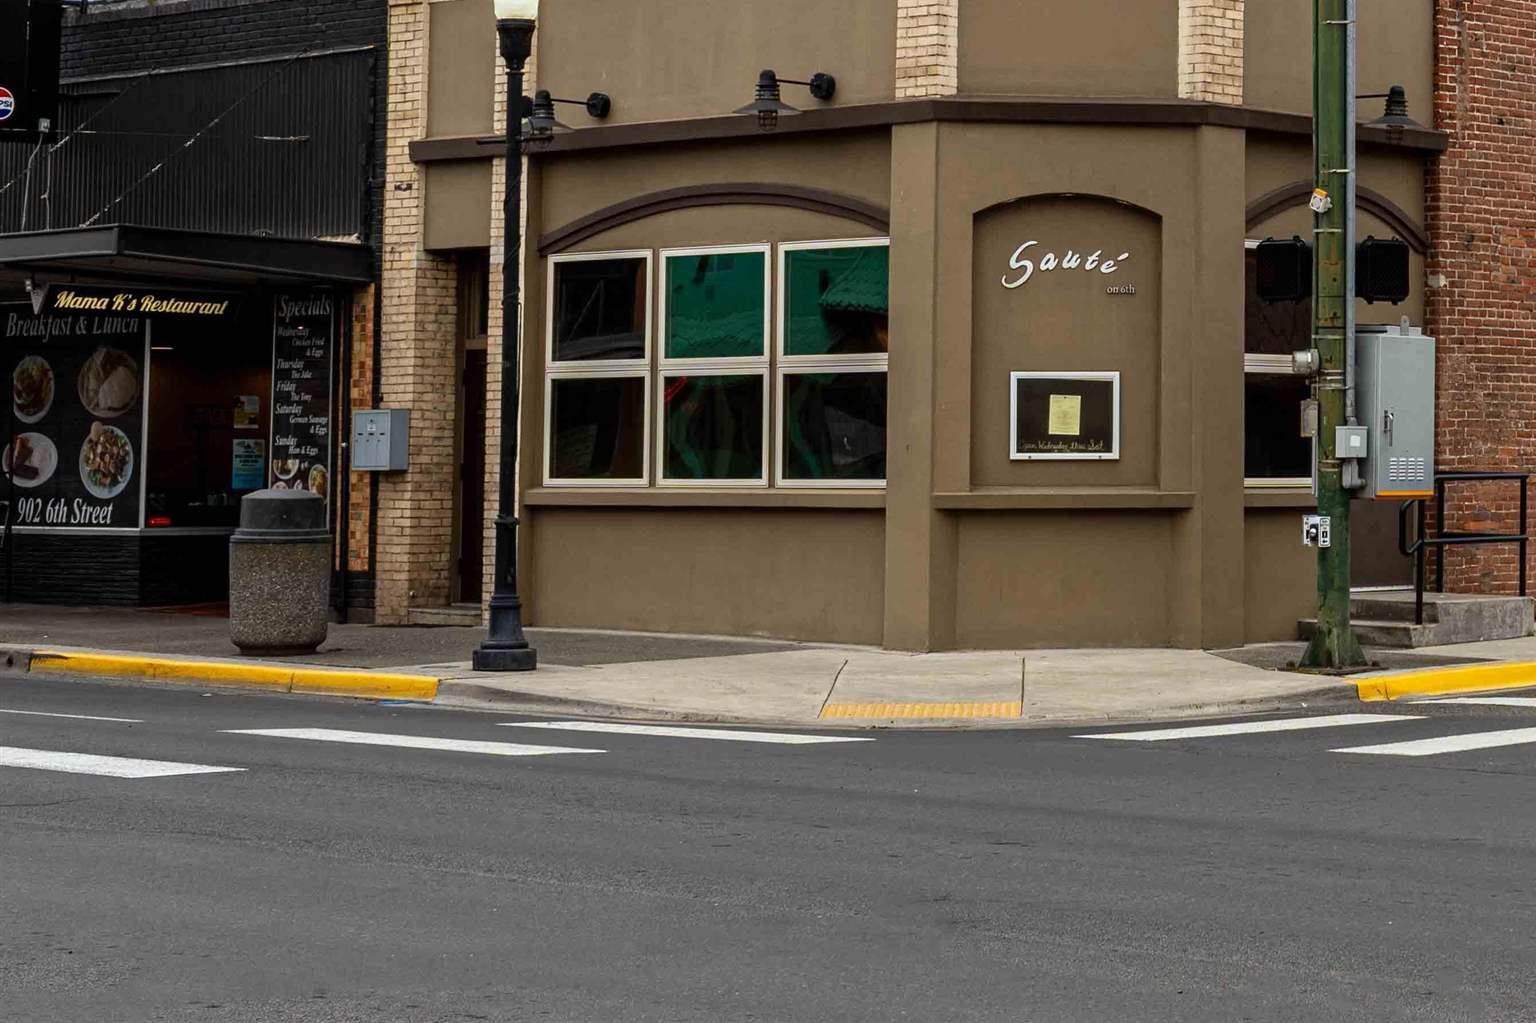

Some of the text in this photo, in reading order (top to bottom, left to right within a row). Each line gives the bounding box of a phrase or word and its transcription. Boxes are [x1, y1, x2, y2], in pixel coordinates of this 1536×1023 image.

[1001, 240, 1129, 289] Sauté
[1106, 284, 1135, 294] on 6th
[54, 291, 229, 315] Mama K's Restaurant
[278, 293, 330, 323] Specials
[6, 313, 72, 343] Breakfast
[75, 316, 88, 336] &
[276, 358, 304, 370] Thursday
[276, 380, 296, 392] Friday
[275, 402, 303, 416] Saturday
[274, 435, 298, 447] Sunday
[17, 497, 113, 525] 902 6th Street
